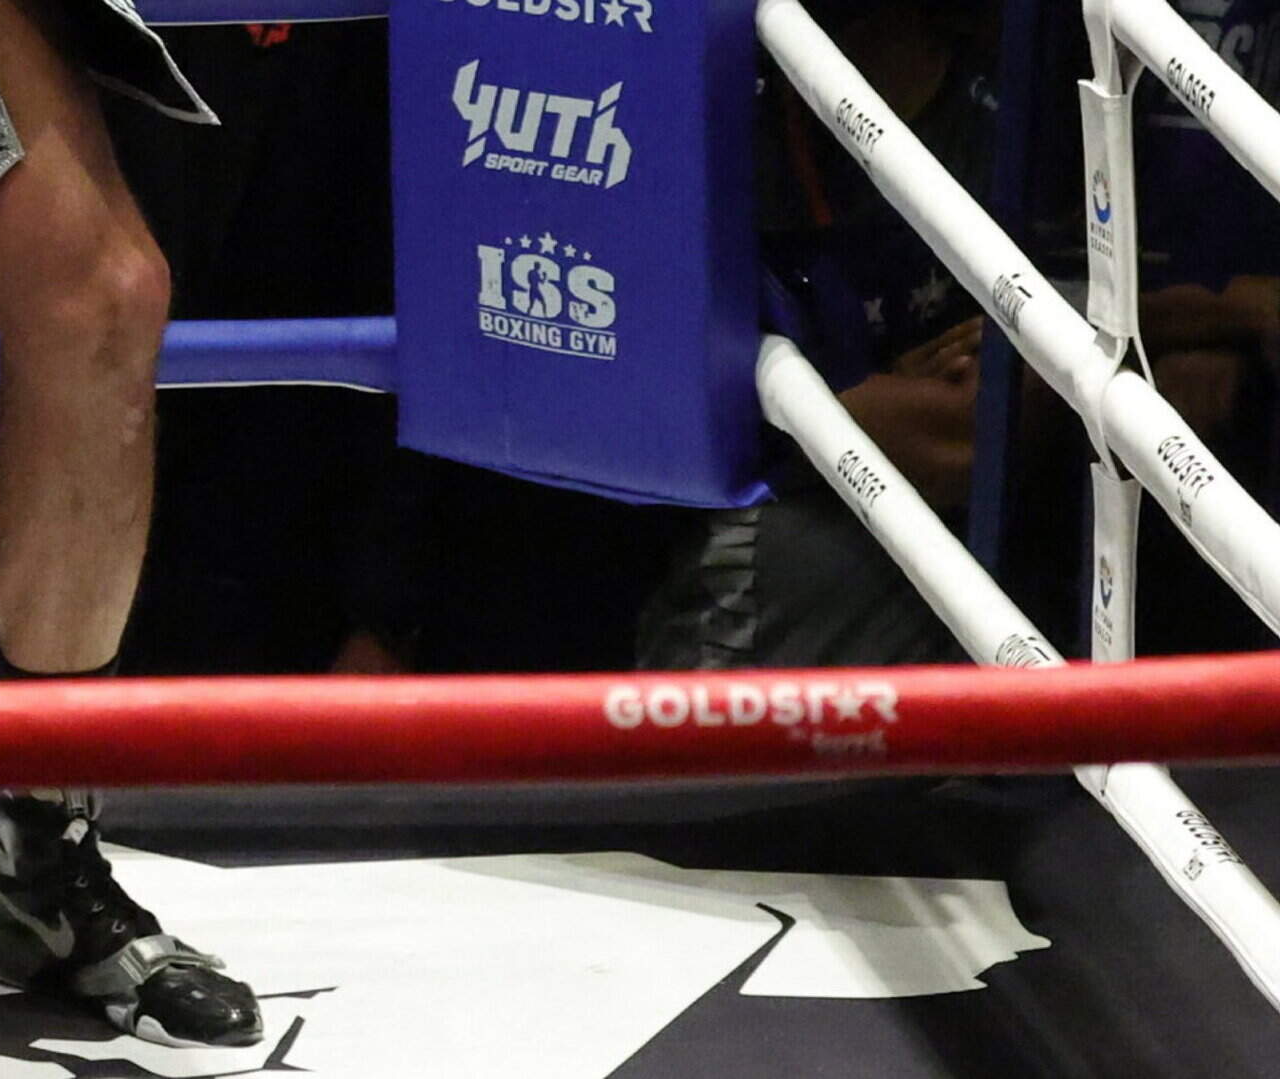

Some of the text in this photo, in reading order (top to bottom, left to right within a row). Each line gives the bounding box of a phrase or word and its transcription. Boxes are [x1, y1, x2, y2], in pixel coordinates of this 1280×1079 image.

[485, 152, 605, 187] SPORT GEAR
[478, 244, 616, 328] ISS
[479, 311, 616, 357] BOXING GYM
